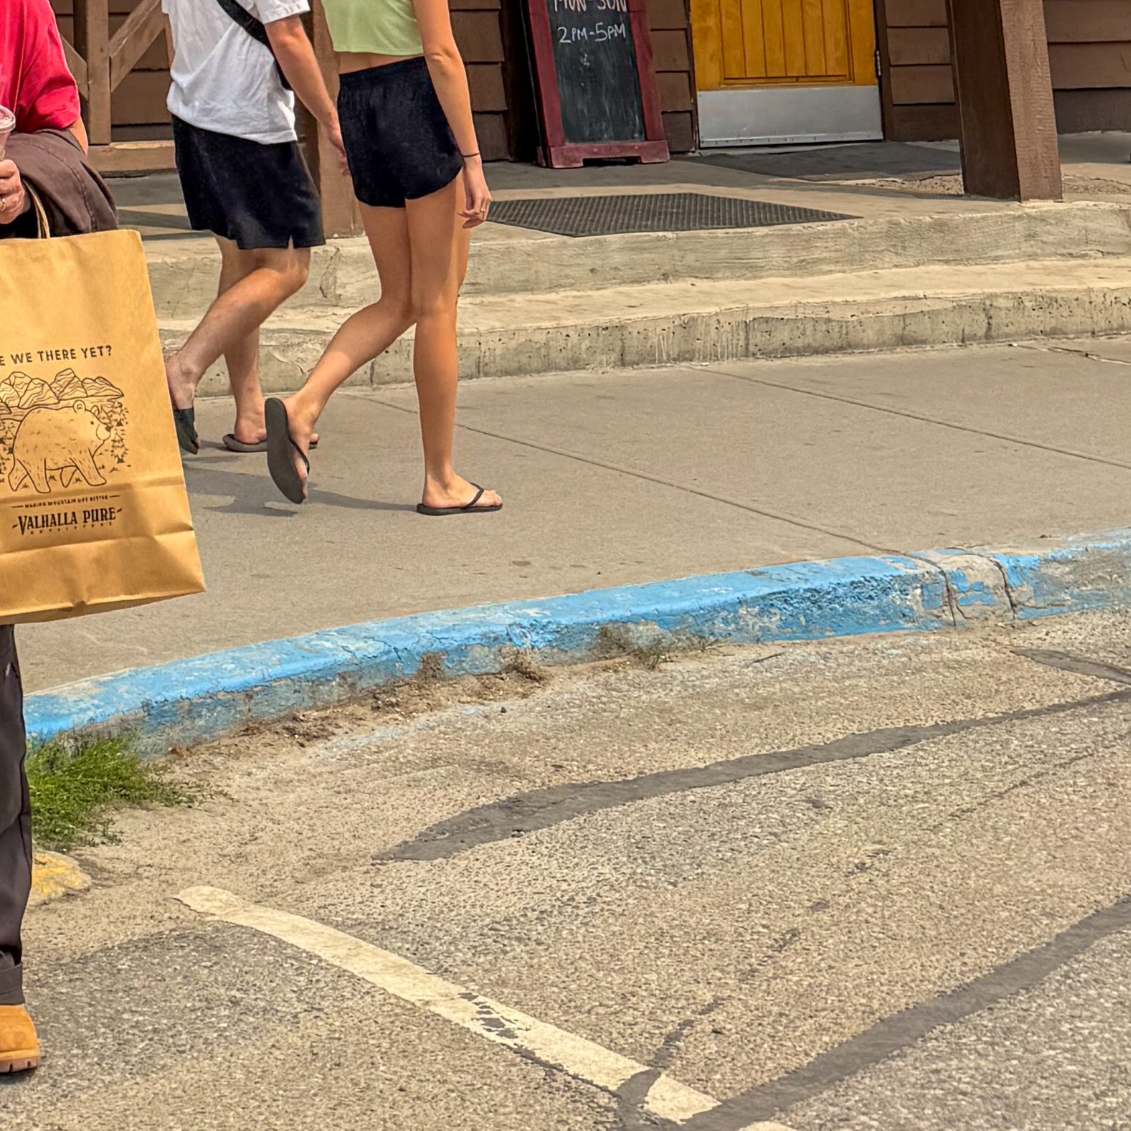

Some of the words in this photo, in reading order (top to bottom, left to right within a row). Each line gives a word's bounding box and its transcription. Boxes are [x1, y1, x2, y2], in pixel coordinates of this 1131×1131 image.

[558, 22, 626, 43] 2PM-5PM
[10, 352, 33, 365] WE
[37, 348, 77, 362] THERE
[81, 344, 113, 359] YET?
[18, 511, 78, 535] VALHALLA
[82, 507, 117, 524] PURE
